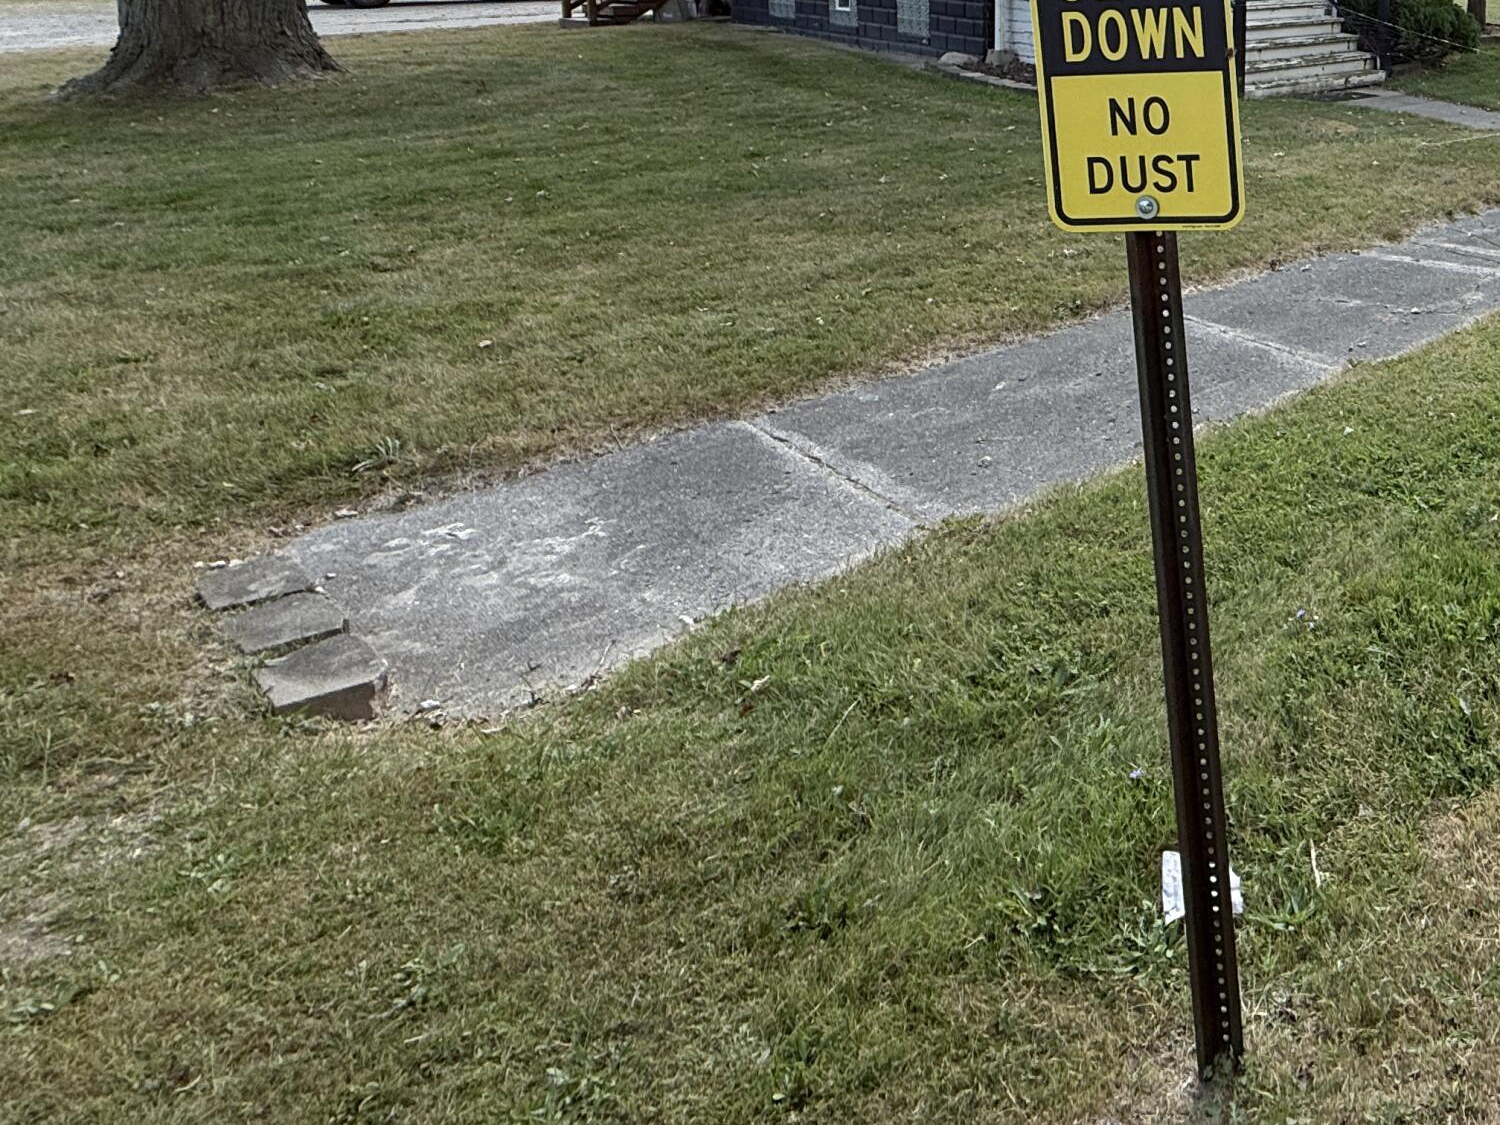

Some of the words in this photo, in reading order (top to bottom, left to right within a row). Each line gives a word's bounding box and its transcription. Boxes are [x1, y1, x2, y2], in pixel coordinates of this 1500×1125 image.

[1061, 6, 1205, 63] DOWN
[1108, 96, 1170, 137] NO
[1086, 154, 1200, 195] DUST
